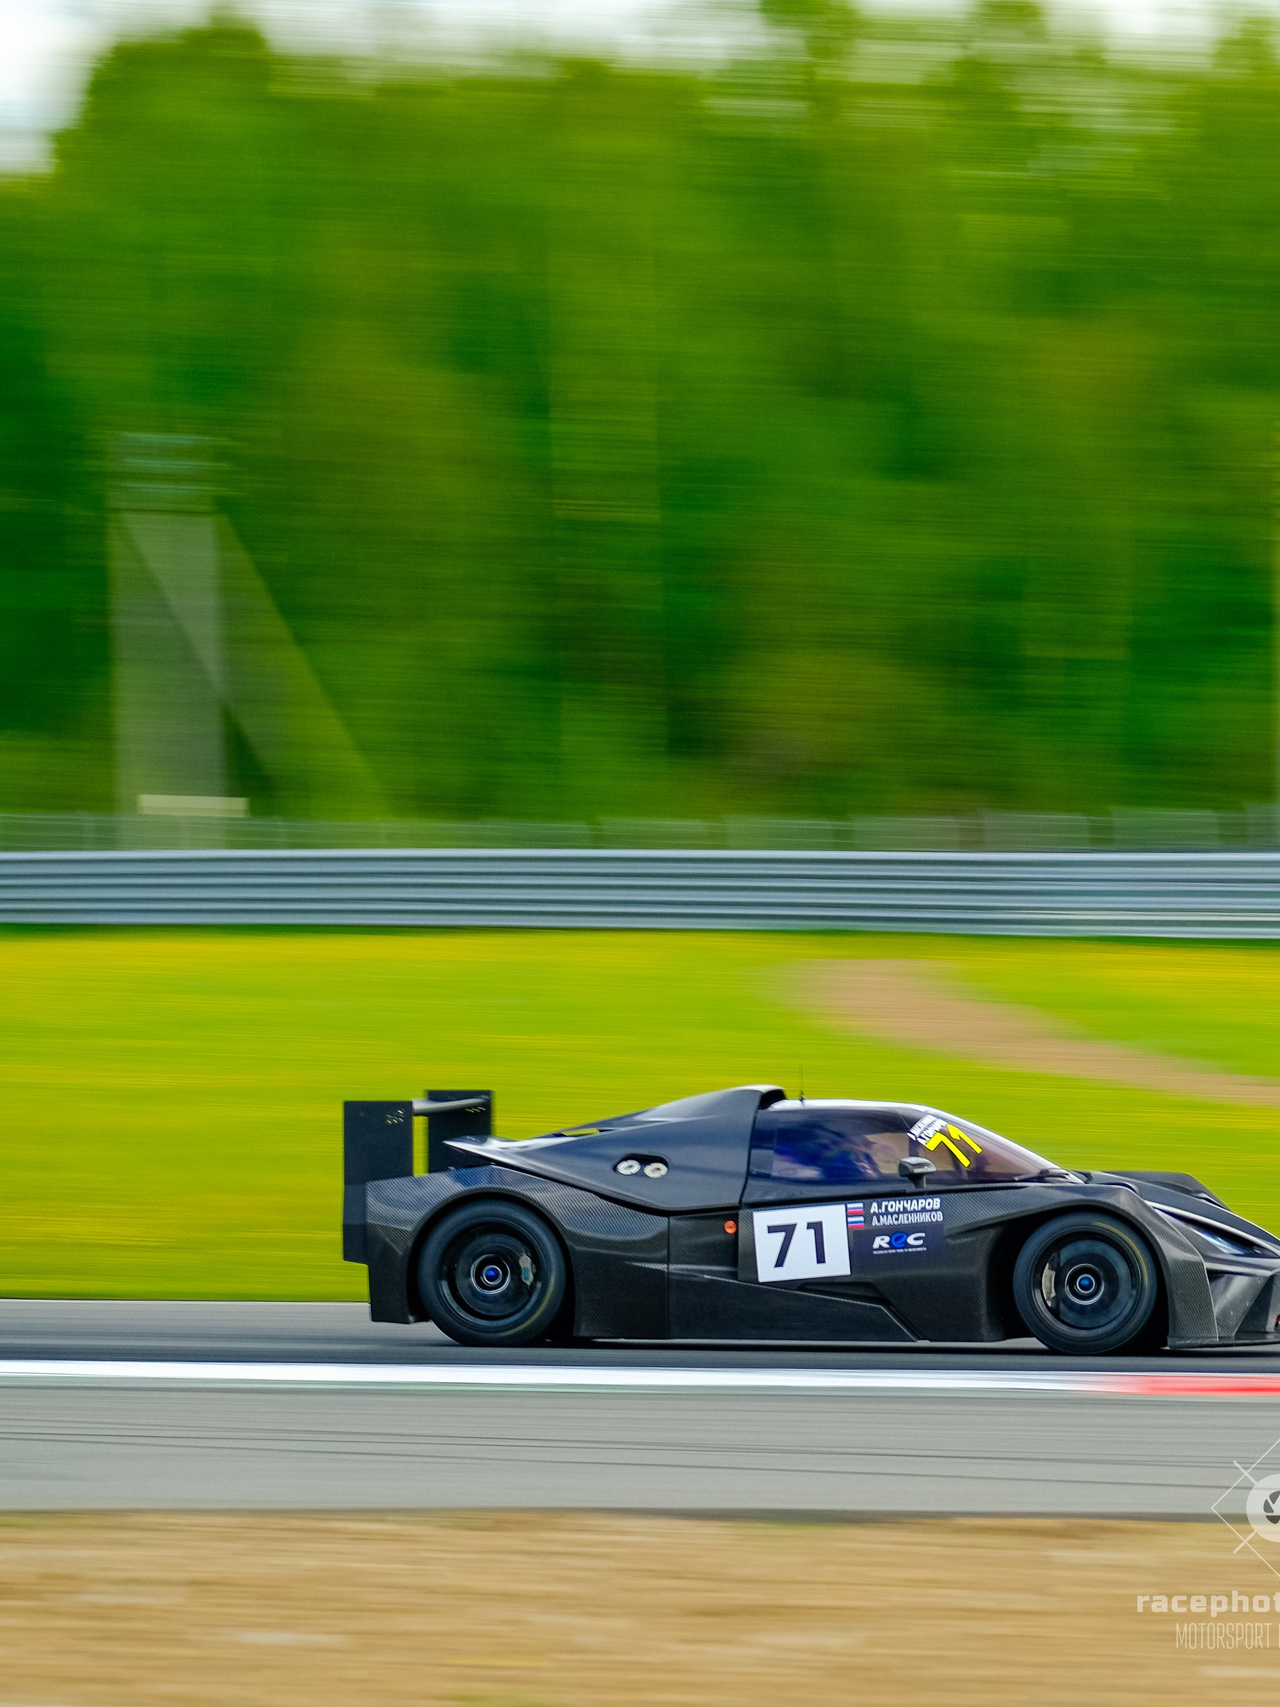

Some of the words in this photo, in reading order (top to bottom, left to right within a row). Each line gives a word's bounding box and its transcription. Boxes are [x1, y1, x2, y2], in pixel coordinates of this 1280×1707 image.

[925, 1123, 983, 1168] 71
[870, 1198, 941, 1214] А.ГОНЧАРОВ
[872, 1211, 944, 1226] А.МАСЛЕННИКОВ
[767, 1220, 826, 1268] 71
